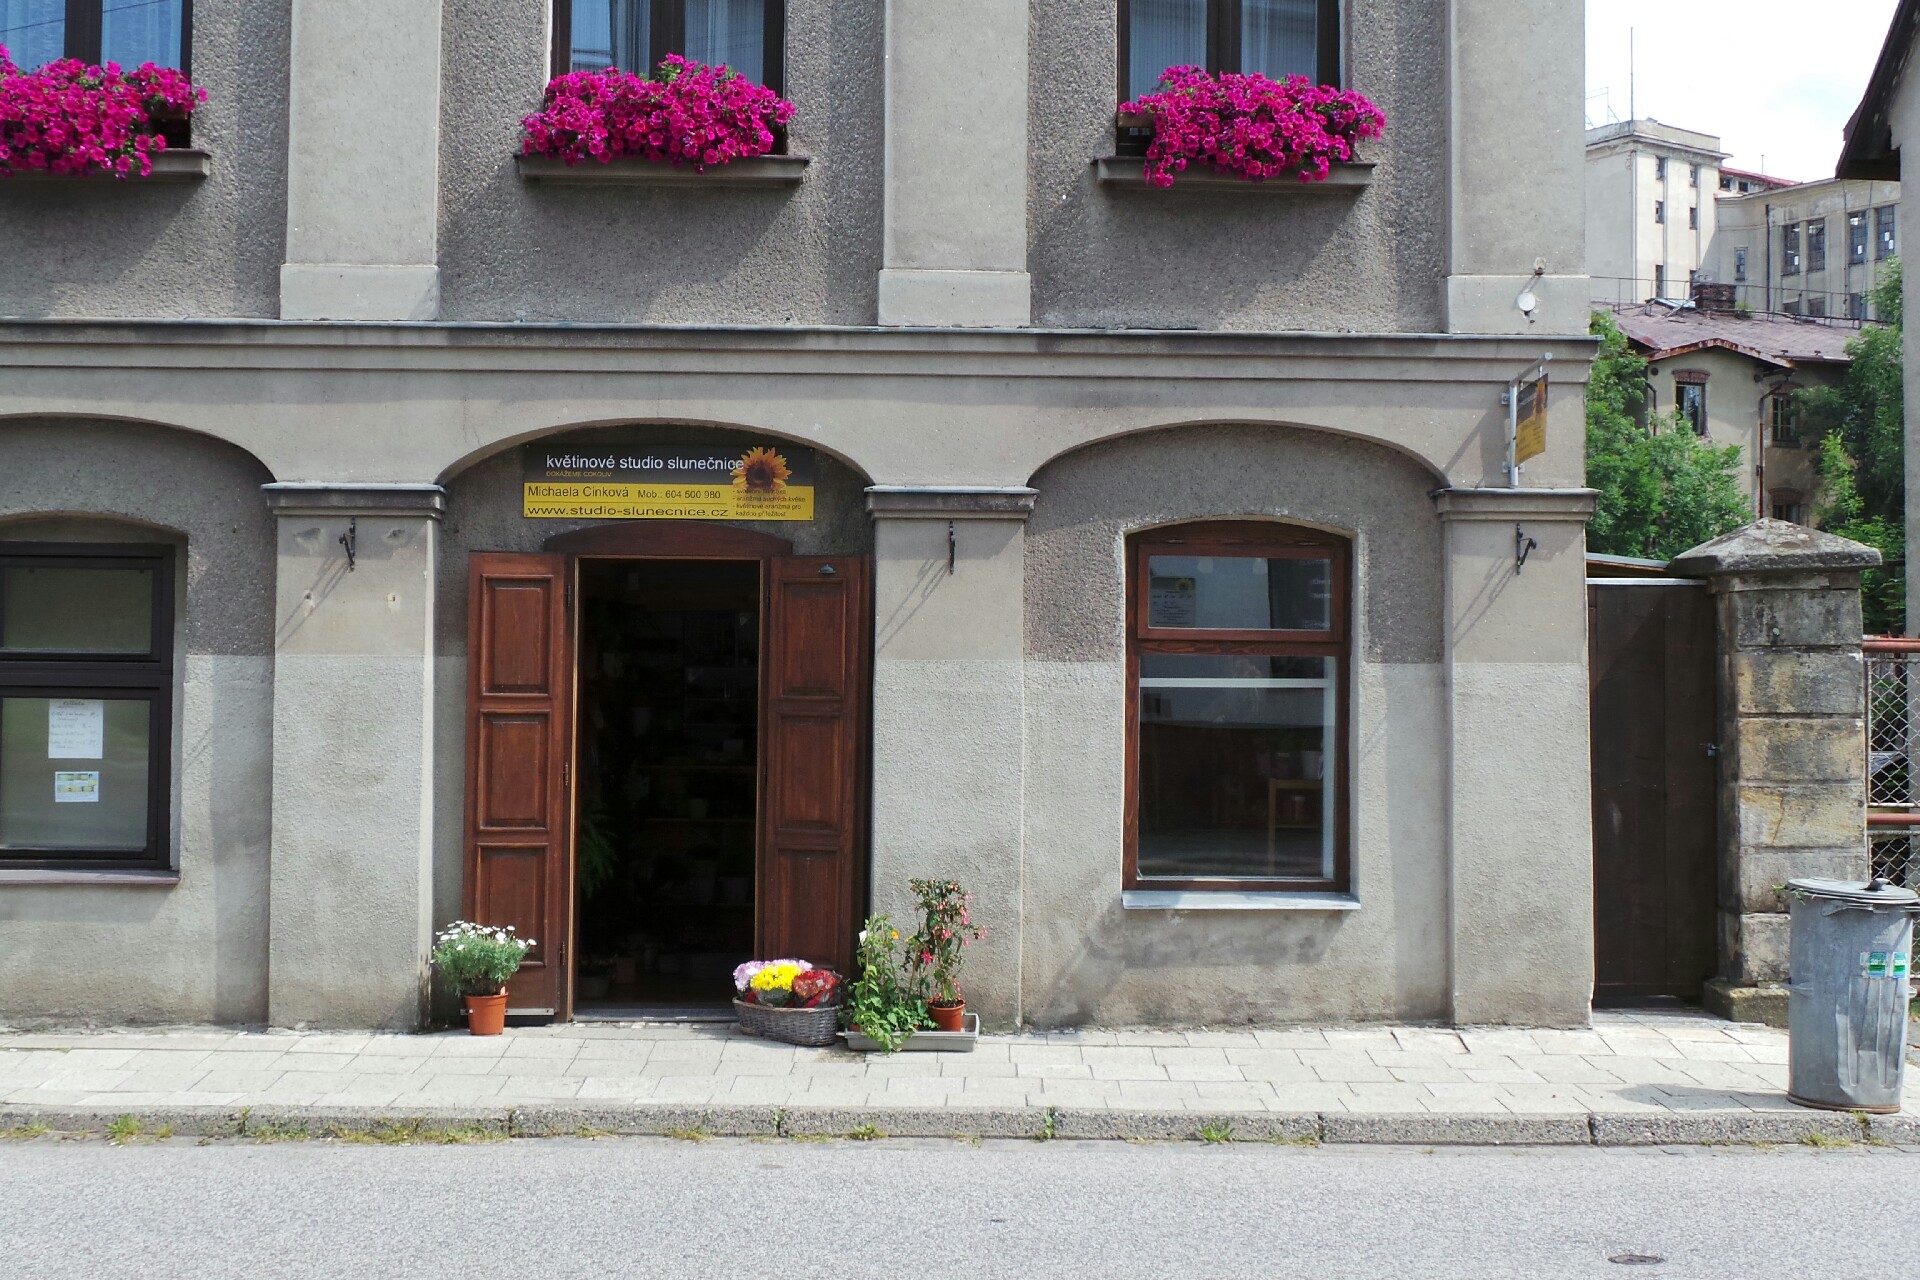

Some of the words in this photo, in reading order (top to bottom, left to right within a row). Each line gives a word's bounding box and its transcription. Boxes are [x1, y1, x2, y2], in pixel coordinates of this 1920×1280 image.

[546, 455, 615, 469] květinové
[619, 456, 663, 469] studio
[667, 456, 744, 470] slunečnice
[528, 486, 579, 497] Michaela
[583, 486, 629, 497] Cinková
[665, 490, 682, 499] 604
[684, 490, 701, 499] 500
[704, 490, 721, 499] 980
[528, 506, 728, 516] www.studio-slunecnice.cz
